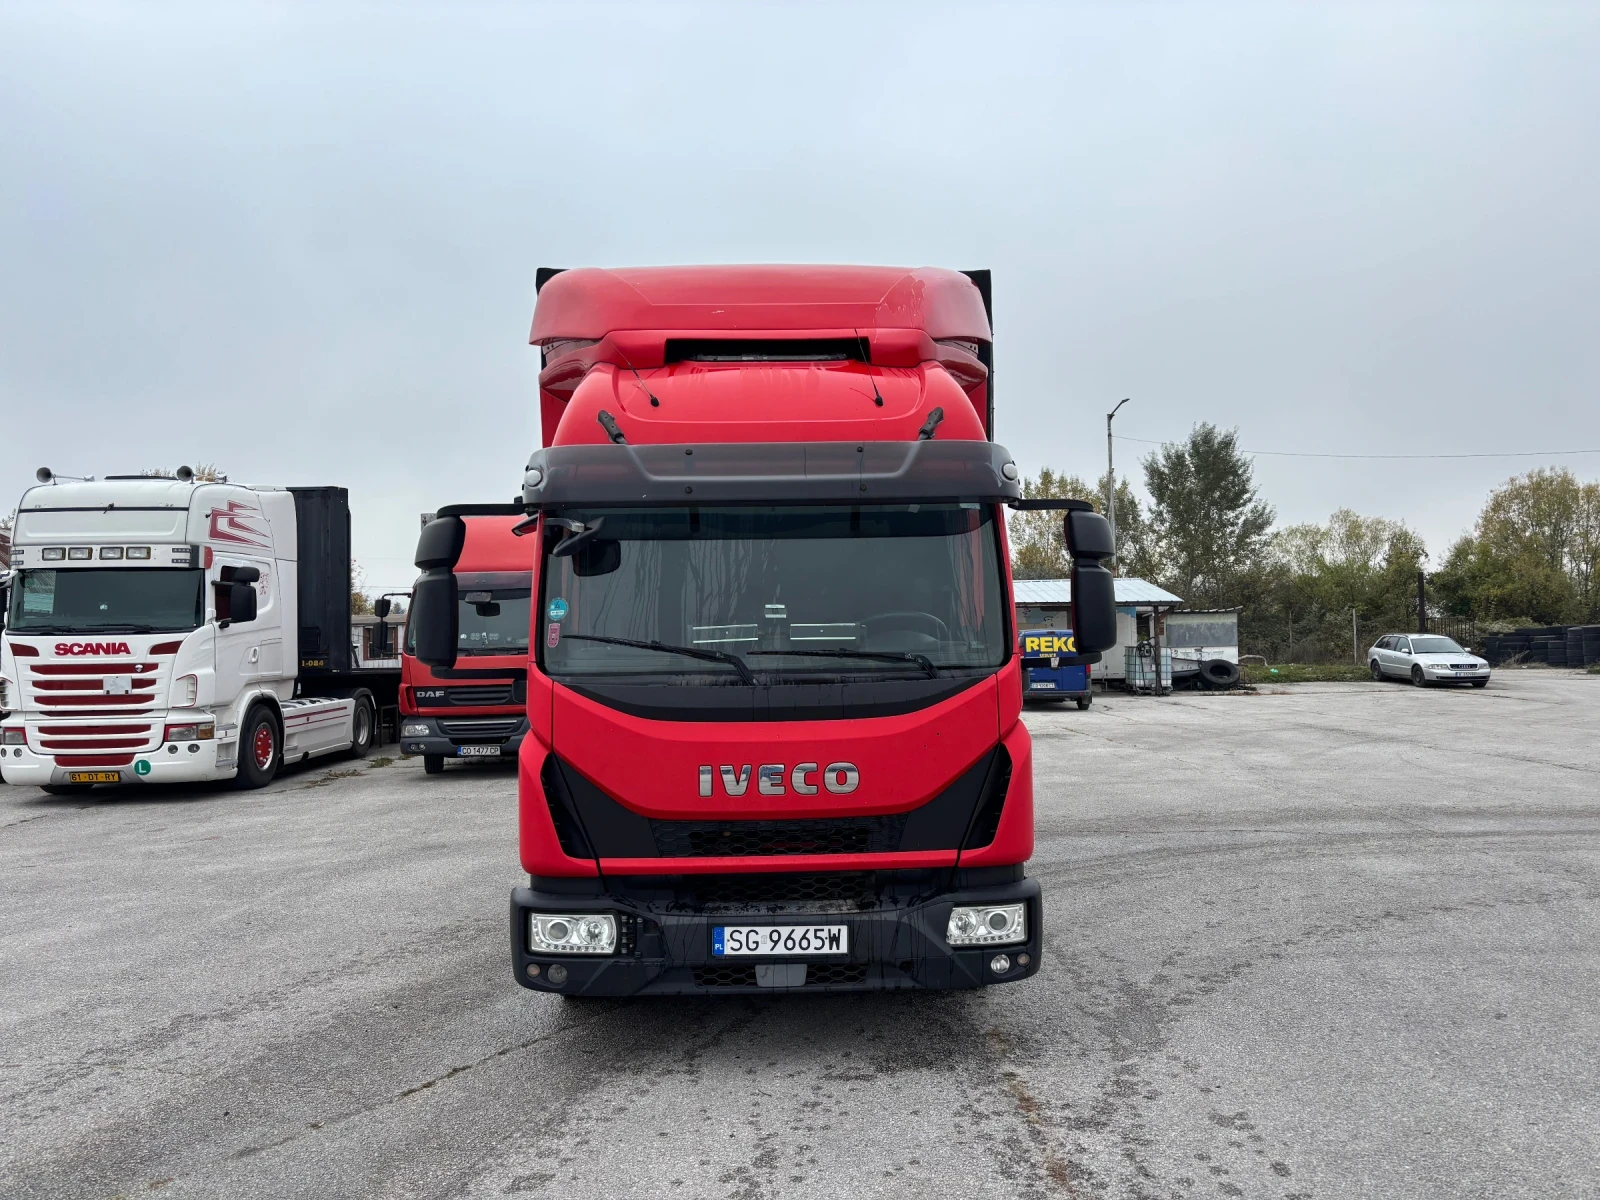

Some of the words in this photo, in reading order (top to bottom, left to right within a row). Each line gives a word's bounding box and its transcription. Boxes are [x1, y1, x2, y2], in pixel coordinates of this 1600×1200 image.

[54, 642, 131, 656] SCANIA
[138, 762, 147, 773] L
[698, 761, 860, 798] IVECO
[729, 929, 759, 951] SG
[769, 928, 842, 951] 9665W
